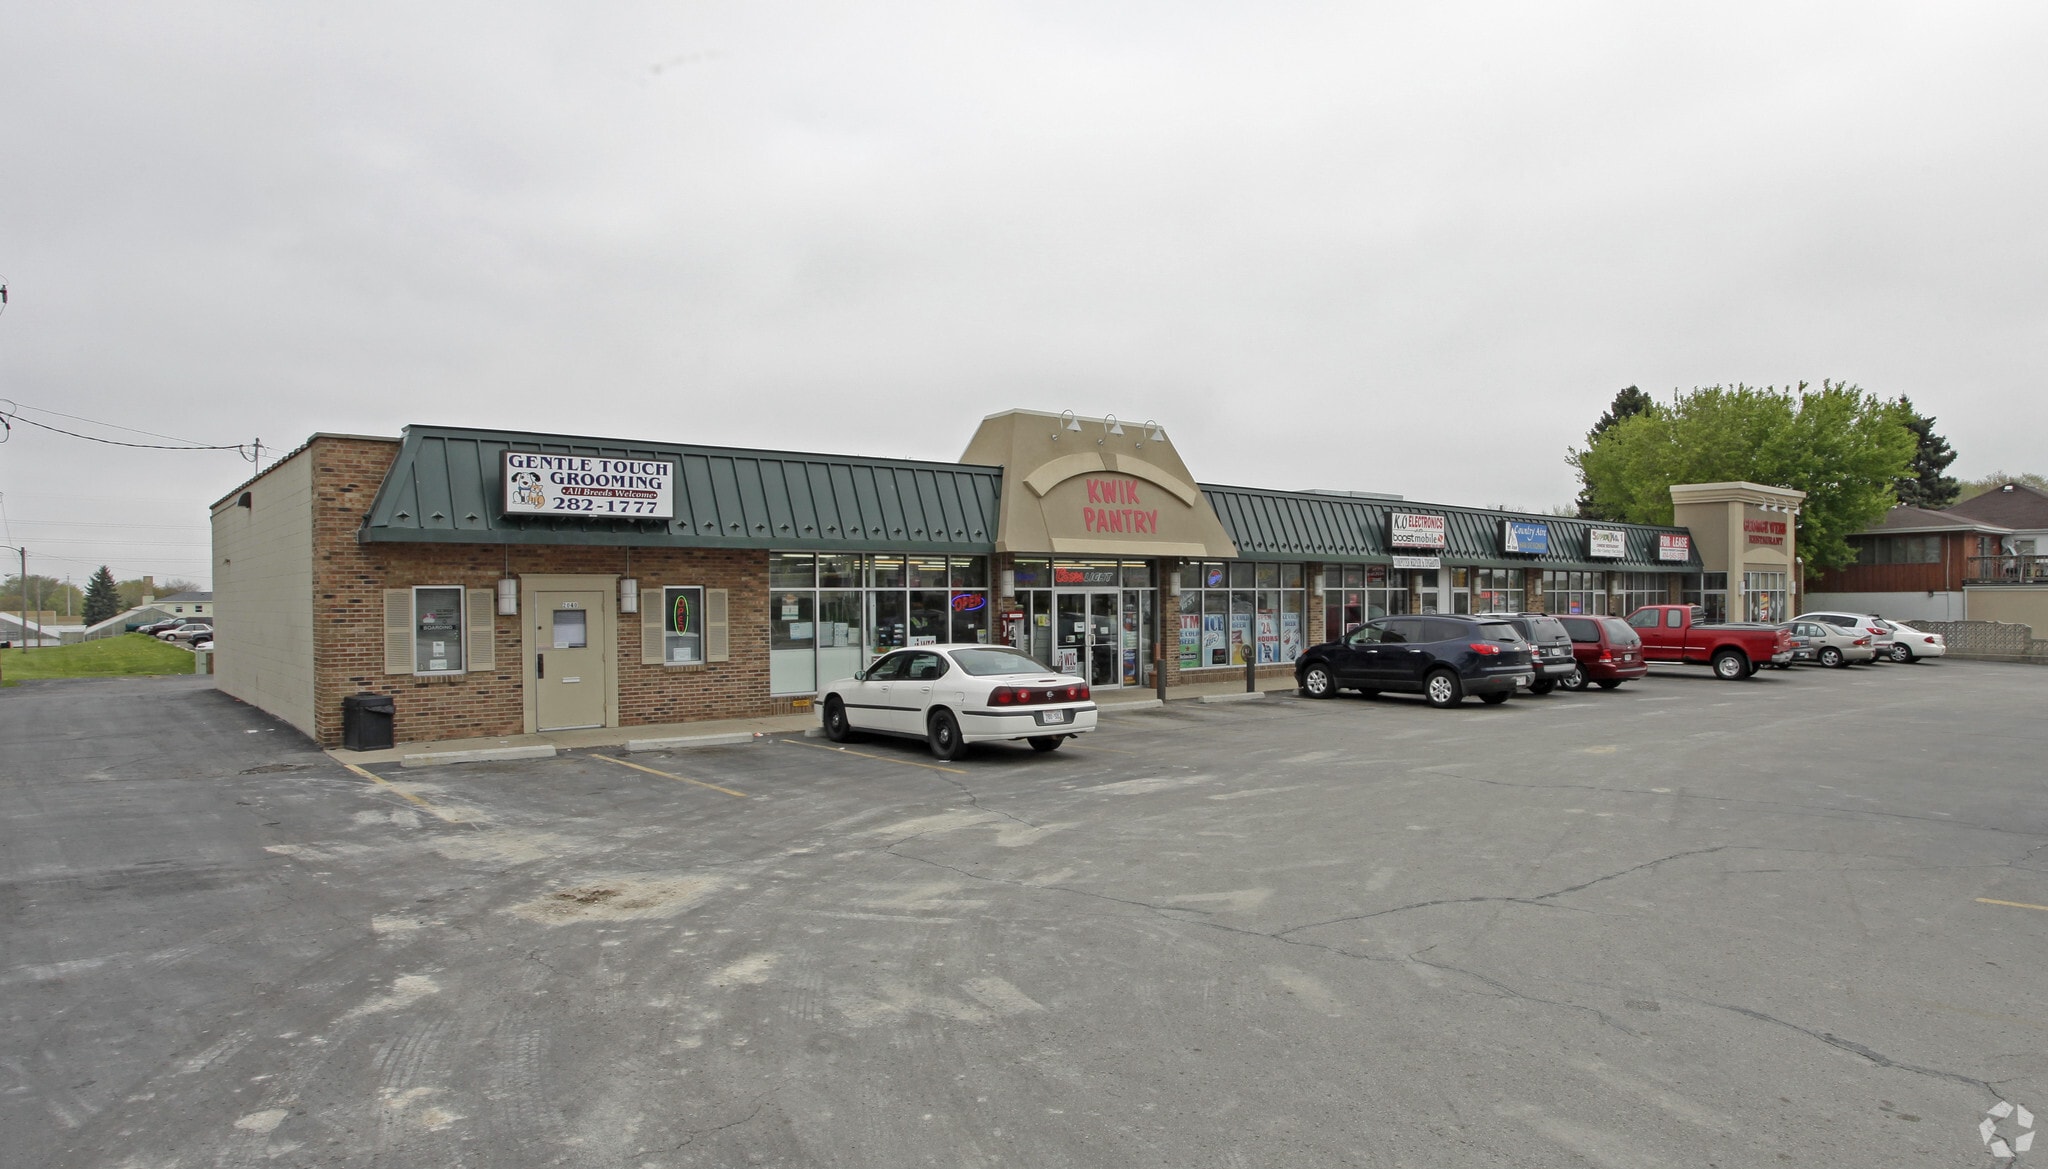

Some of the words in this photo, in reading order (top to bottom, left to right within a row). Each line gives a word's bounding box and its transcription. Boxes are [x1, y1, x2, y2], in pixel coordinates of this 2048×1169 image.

[508, 454, 593, 472] GENTLE
[599, 460, 668, 476] TOUCH
[550, 471, 663, 490] GROOMING
[566, 487, 582, 496] All
[583, 488, 613, 497] Breeds
[613, 490, 654, 499] Welcome
[1086, 479, 1141, 505] KWIK
[552, 497, 658, 514] 282-1777
[1083, 507, 1158, 535] PANTRY
[1408, 515, 1443, 529] ELECTRONICS
[1393, 533, 1415, 543] boost
[1414, 533, 1437, 544] mobile
[1514, 524, 1535, 541] Country
[1748, 534, 1784, 546] RESTAURANT
[1660, 535, 1671, 547] FOR
[1672, 536, 1688, 548] LEASE
[1055, 567, 1084, 583] Coors
[1084, 572, 1114, 583] LIGHT
[954, 593, 982, 612] OPEN
[677, 598, 685, 632] OPEN
[1204, 615, 1224, 632] ICE
[1261, 622, 1272, 634] 24
[1064, 652, 1076, 666] WIC
